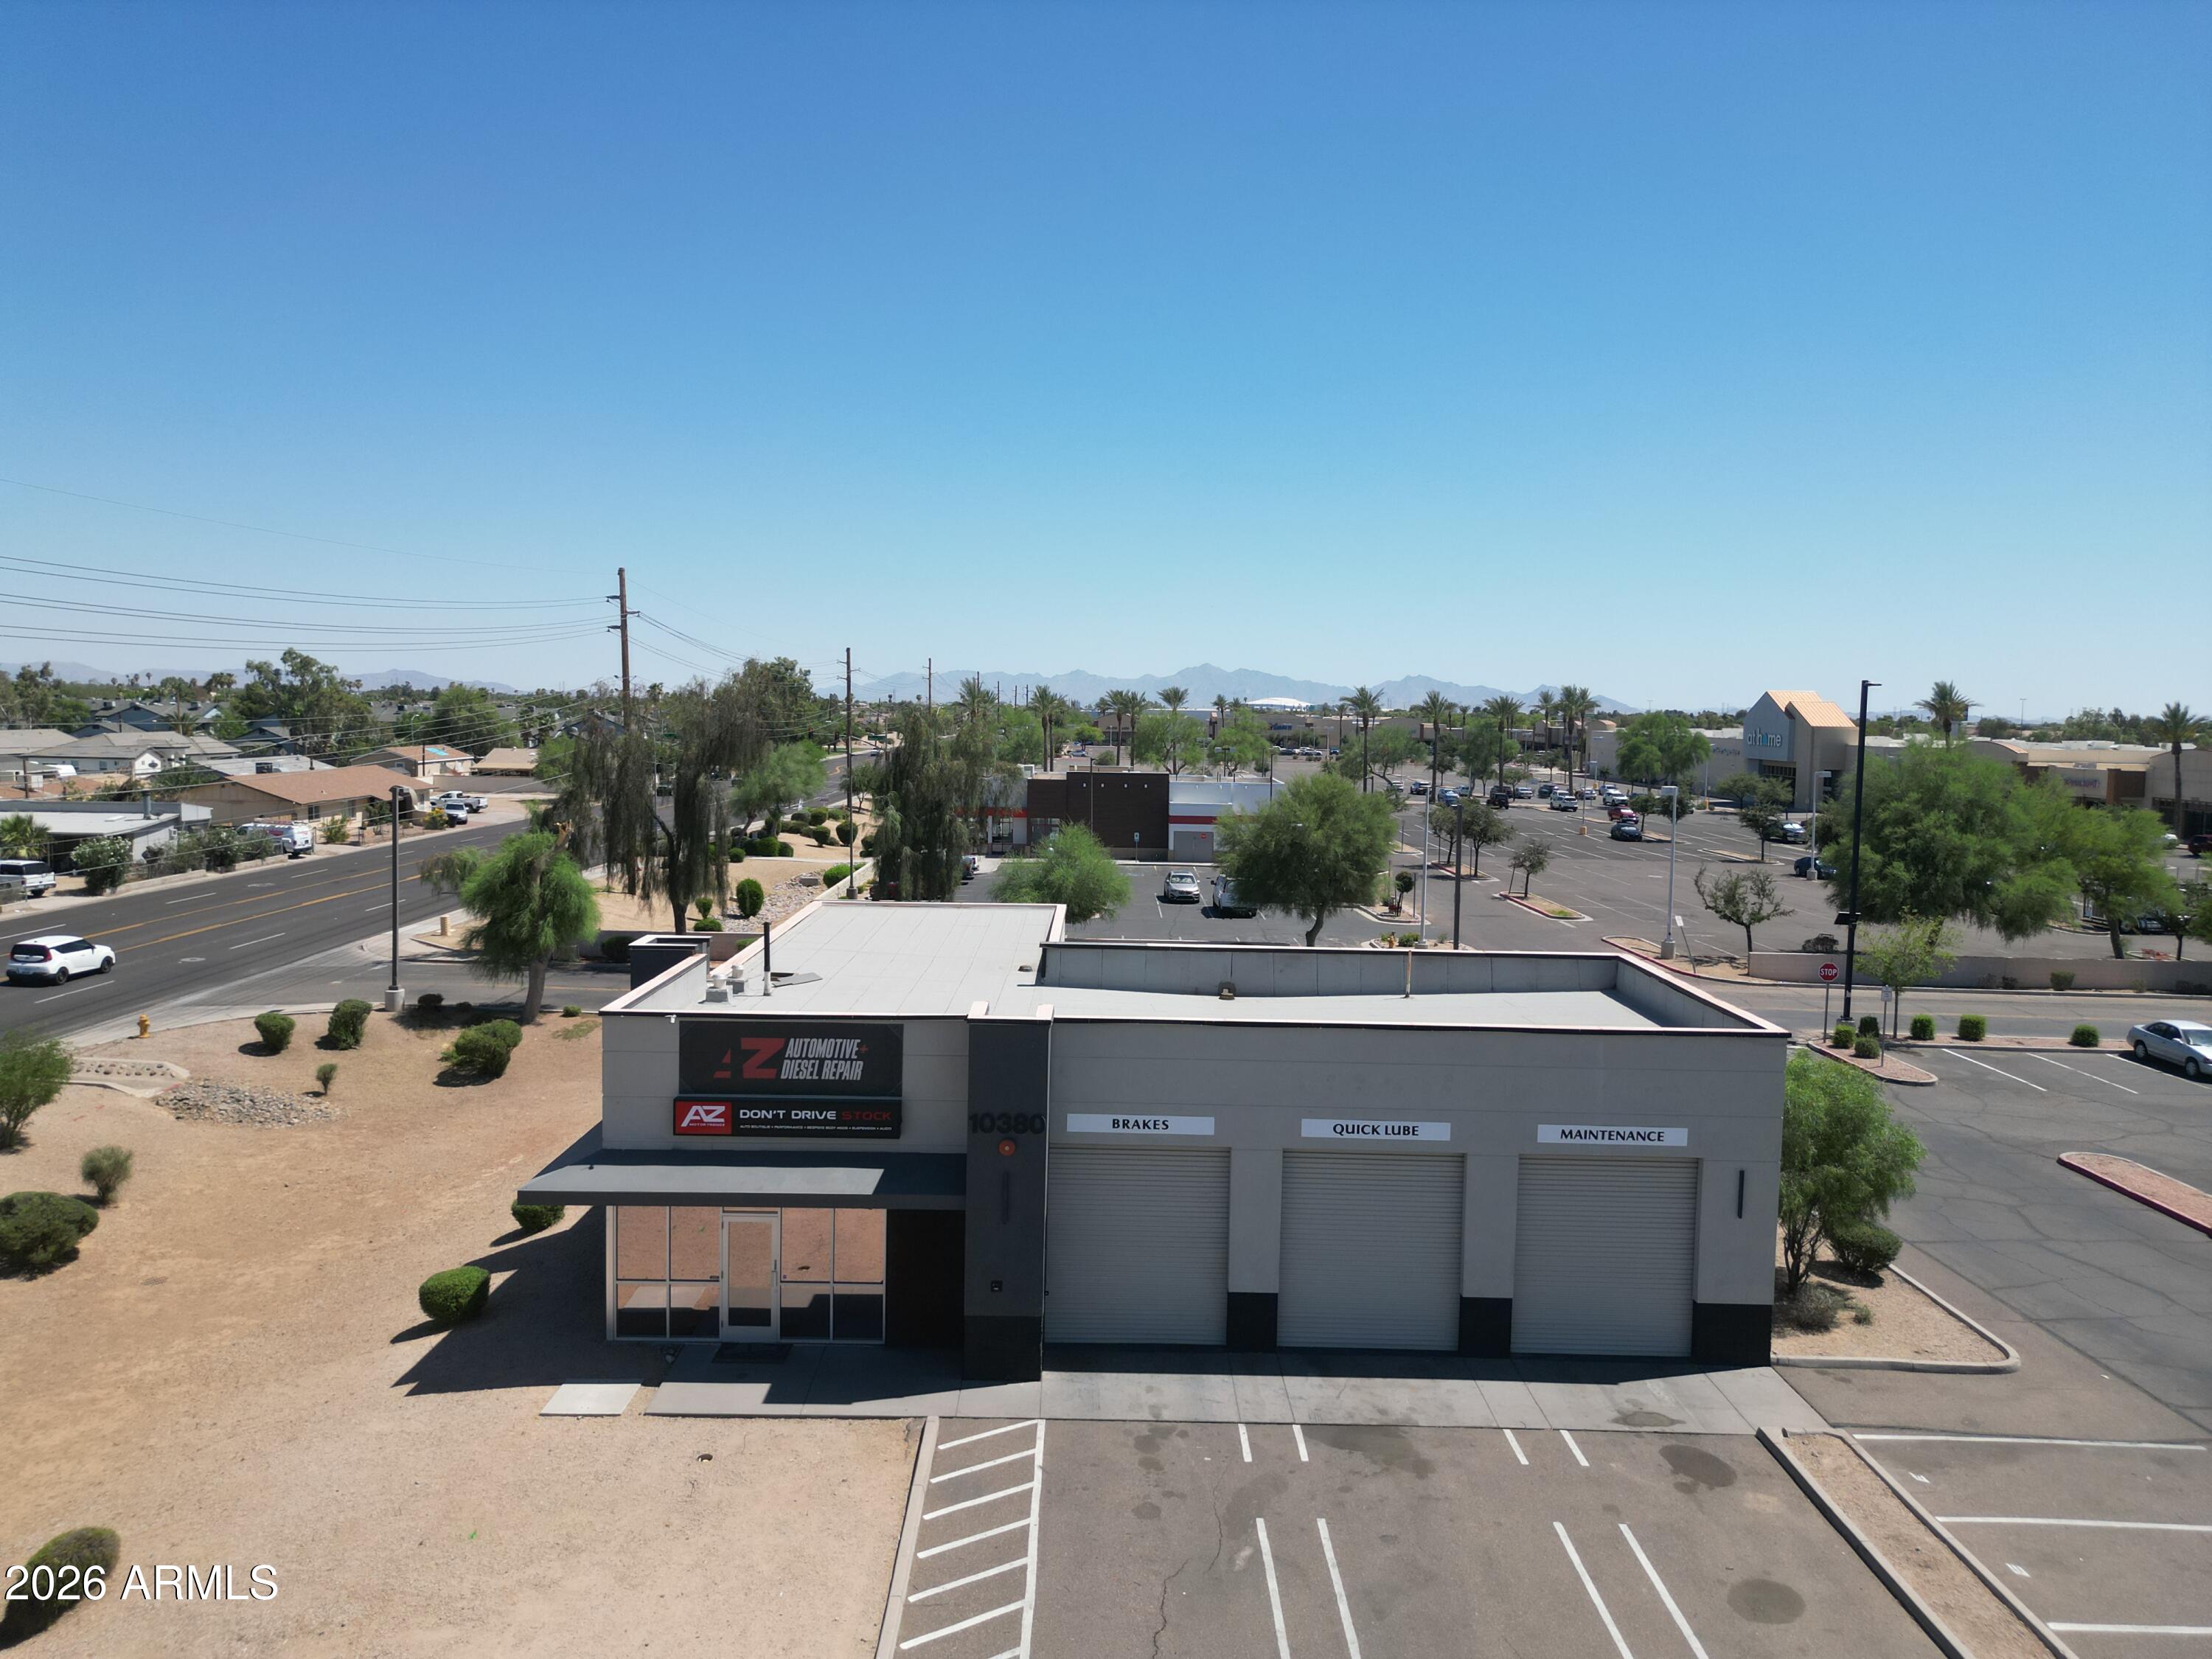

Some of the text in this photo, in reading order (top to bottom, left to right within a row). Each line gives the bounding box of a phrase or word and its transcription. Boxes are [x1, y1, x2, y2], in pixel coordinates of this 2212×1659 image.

[1747, 730, 1756, 745] at
[1820, 968, 1837, 976] STOP
[785, 1037, 861, 1059] AUTOMOTIVE
[780, 1060, 863, 1081] DIESEL REPAIR
[681, 1105, 726, 1127] AZ
[740, 1109, 892, 1121] DON'T DRIVE STOCK
[968, 1112, 1046, 1135] 10380
[1112, 1119, 1169, 1130] BRAKES
[1332, 1123, 1419, 1136] QUICK LUBE
[1560, 1129, 1665, 1142] MAINTENANCE
